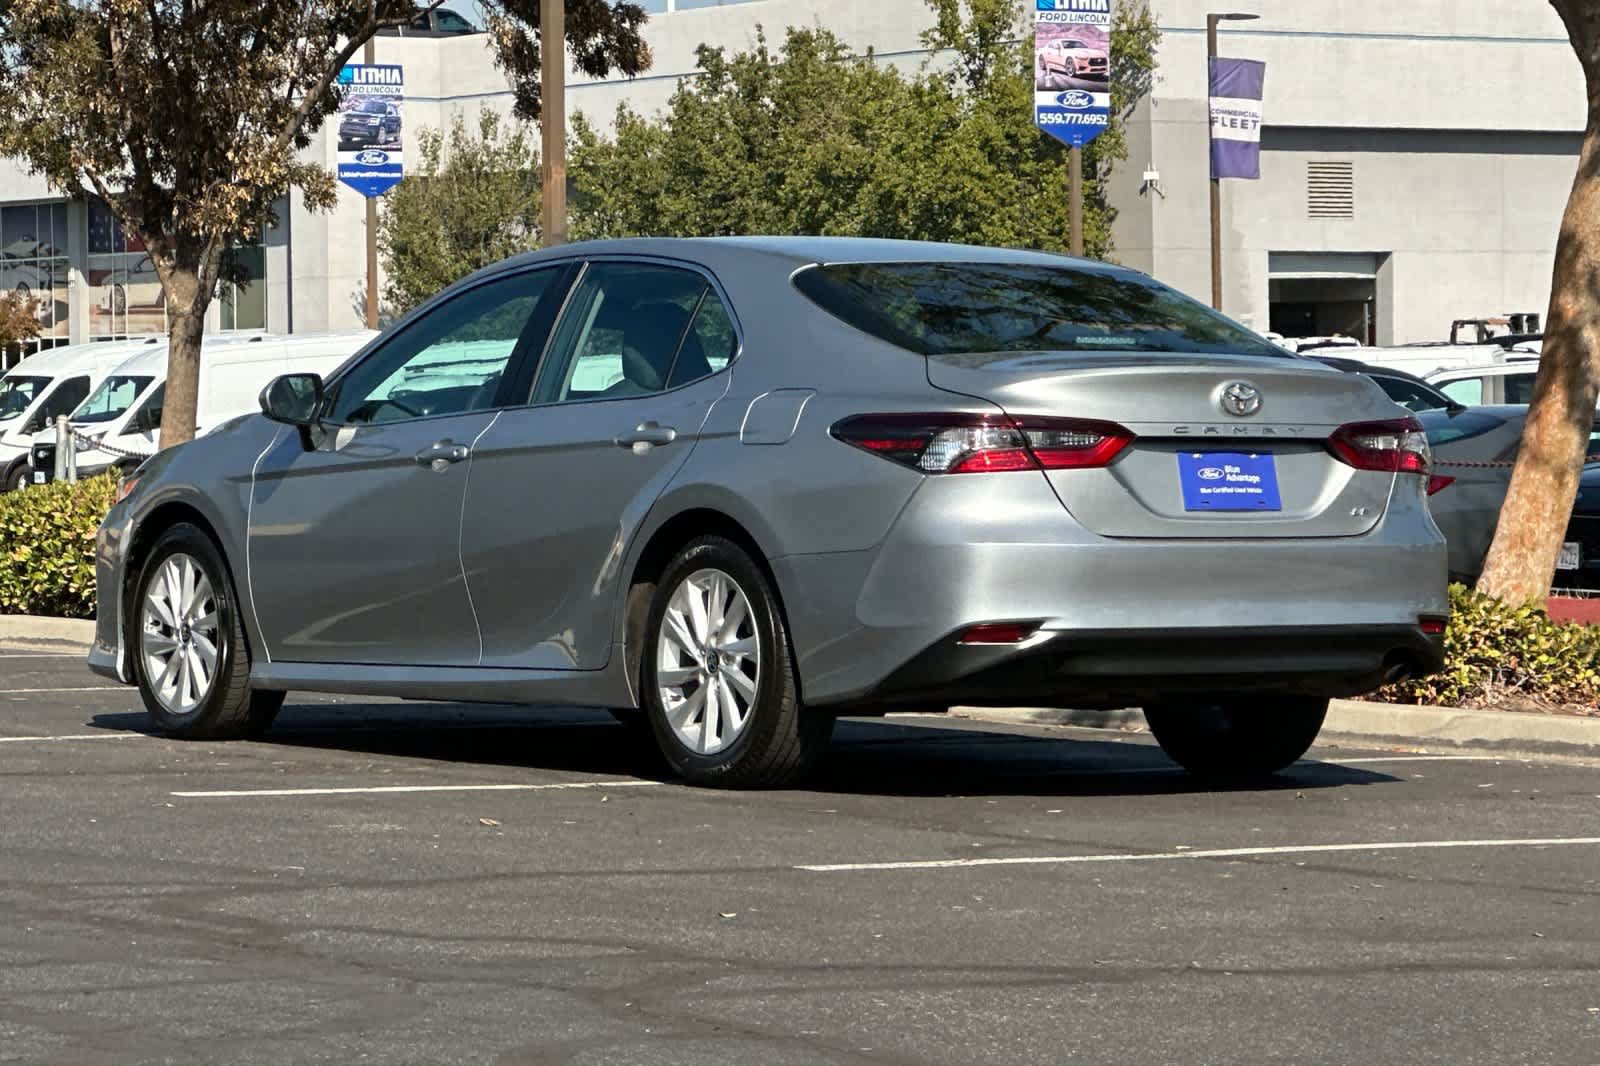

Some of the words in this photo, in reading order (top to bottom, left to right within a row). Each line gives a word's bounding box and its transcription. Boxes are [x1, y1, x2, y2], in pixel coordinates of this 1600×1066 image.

[1039, 13, 1068, 21] FORD
[1070, 14, 1107, 23] LINCOLN
[353, 67, 401, 84] LITHIA
[366, 86, 401, 94] LINCOLN
[1062, 92, 1090, 106] Ford
[1039, 112, 1108, 125] 559.777.6952
[1211, 116, 1260, 130] FLEET
[360, 151, 386, 163] Ford
[1172, 425, 1305, 435] CAMRY
[1224, 464, 1241, 473] Blue
[1226, 473, 1261, 484] Advantage
